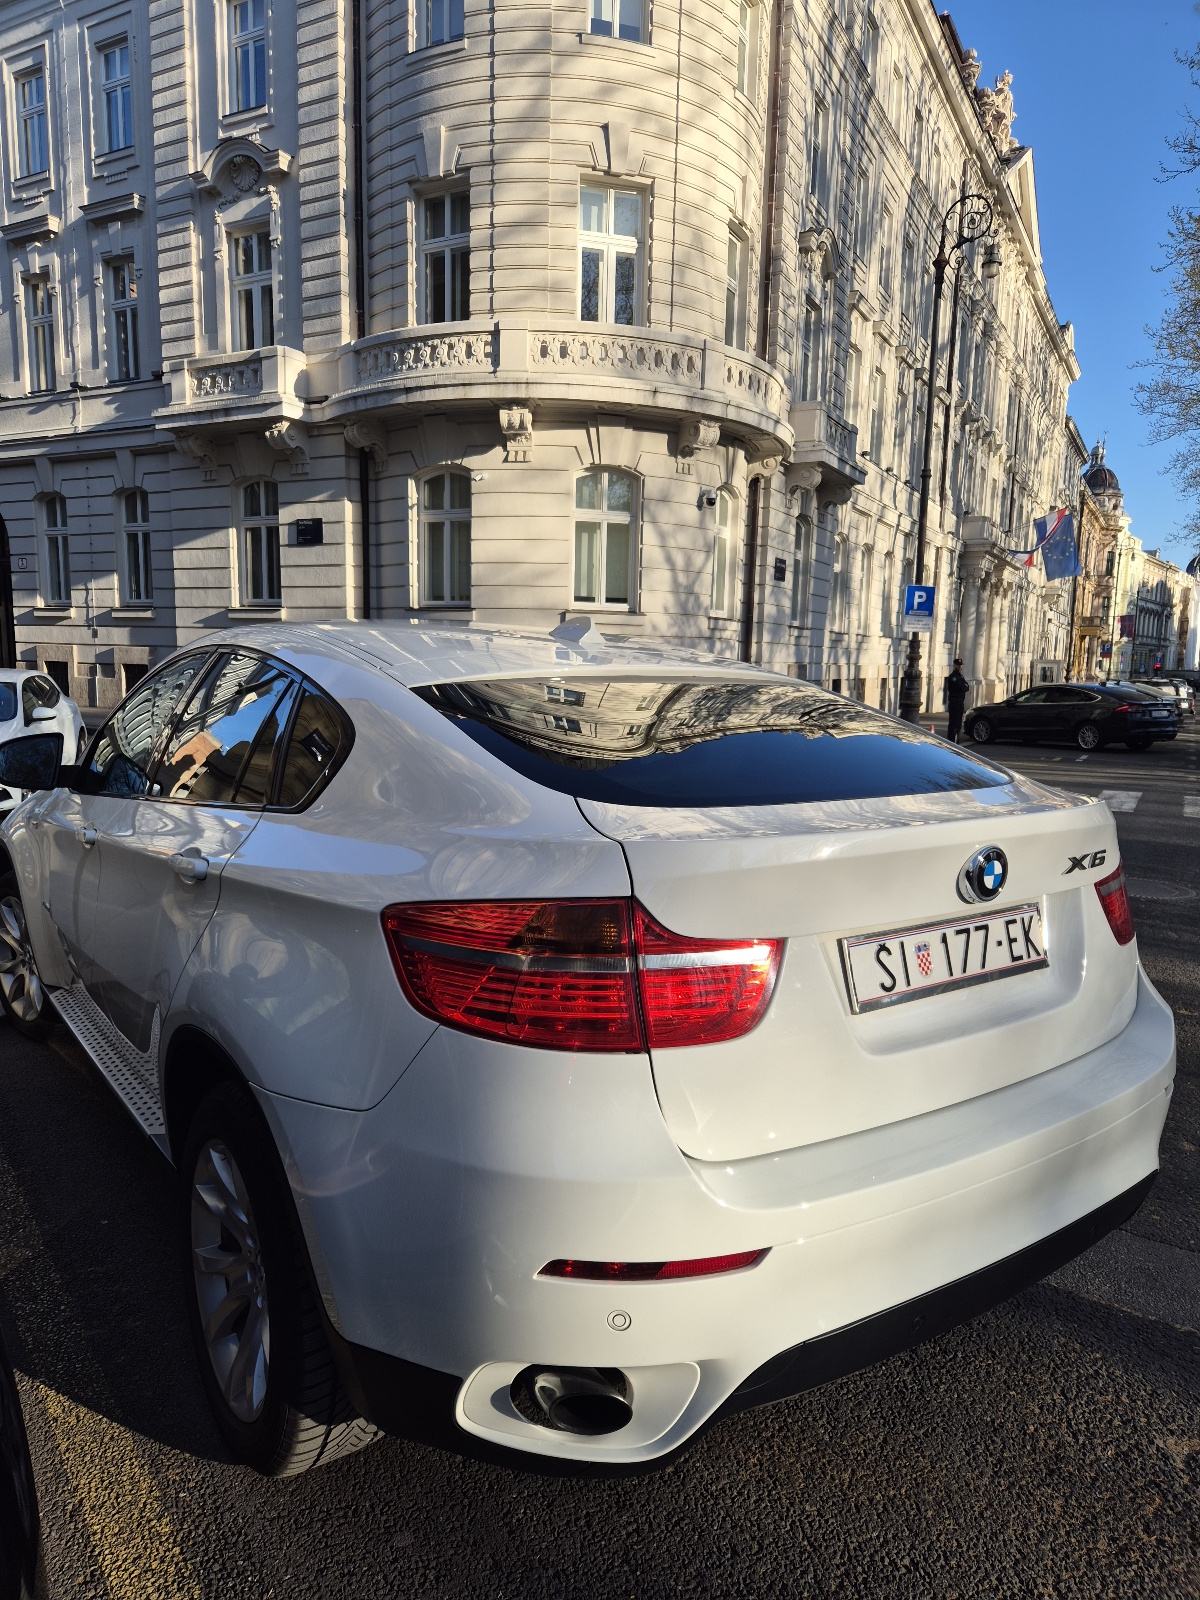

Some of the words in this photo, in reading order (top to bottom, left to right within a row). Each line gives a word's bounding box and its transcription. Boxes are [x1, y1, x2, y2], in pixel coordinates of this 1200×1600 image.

[913, 591, 927, 610] P
[1061, 849, 1107, 875] X6
[874, 940, 911, 993] ŠI
